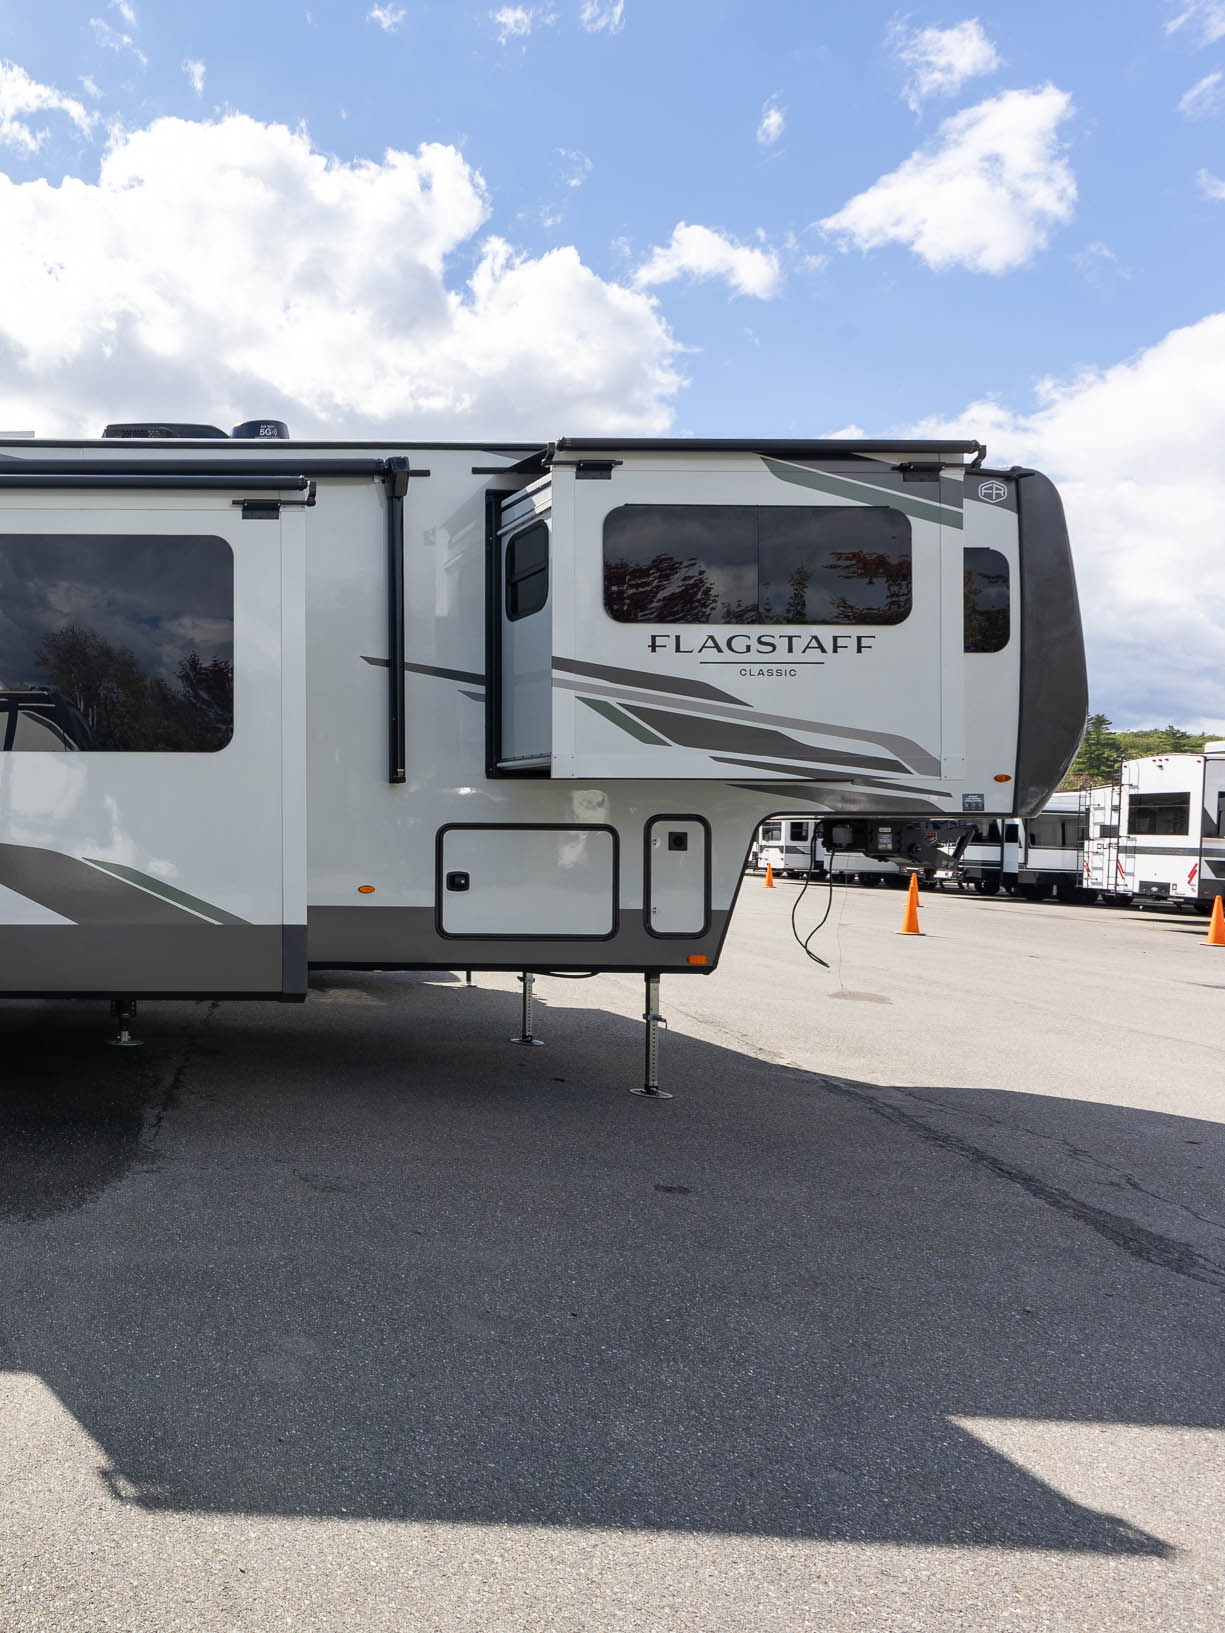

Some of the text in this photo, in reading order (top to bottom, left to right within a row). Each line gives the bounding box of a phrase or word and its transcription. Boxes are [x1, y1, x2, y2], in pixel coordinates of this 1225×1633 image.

[259, 428, 272, 436] 5G
[648, 634, 876, 654] FLAGSTAFF
[739, 668, 797, 677] CLASSIC
